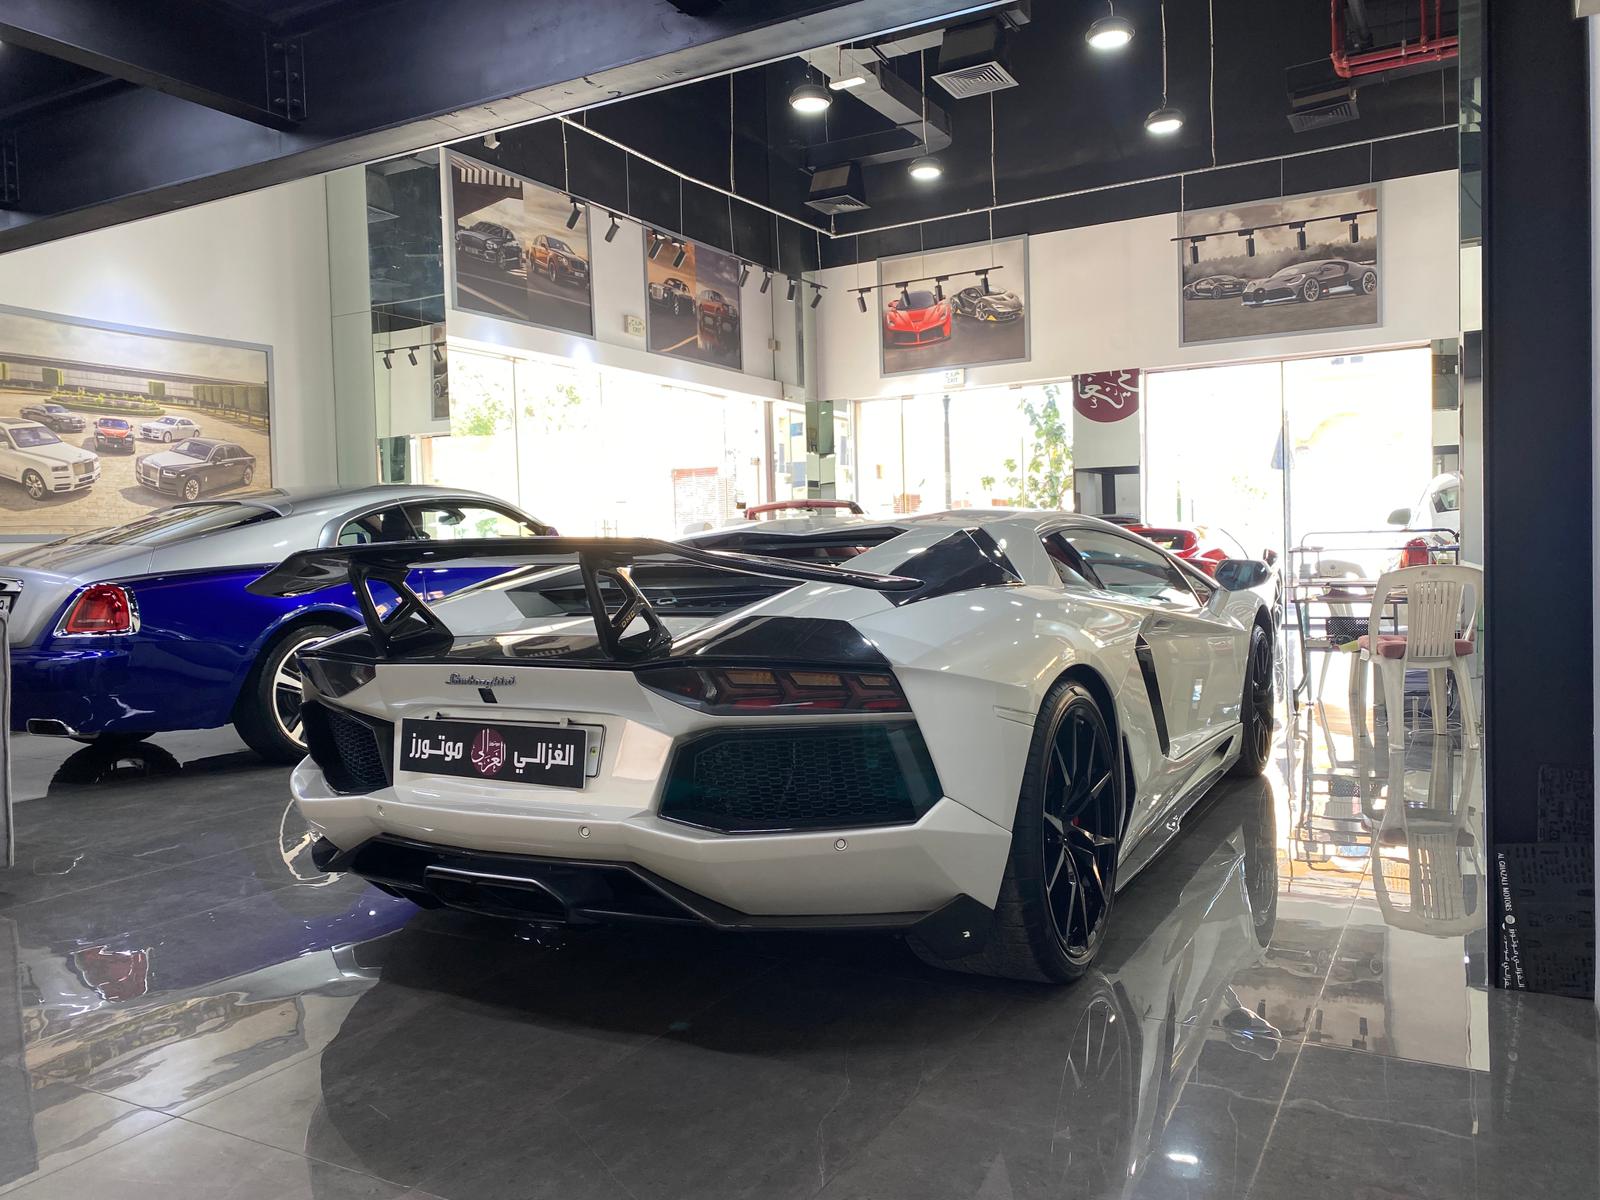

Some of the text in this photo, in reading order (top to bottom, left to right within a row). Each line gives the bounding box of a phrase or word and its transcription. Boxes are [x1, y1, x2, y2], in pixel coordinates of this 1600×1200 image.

[621, 610, 636, 628] DMC
[409, 732, 575, 774] الغزالي موتورز
[1503, 887, 1512, 912] MOTORS
